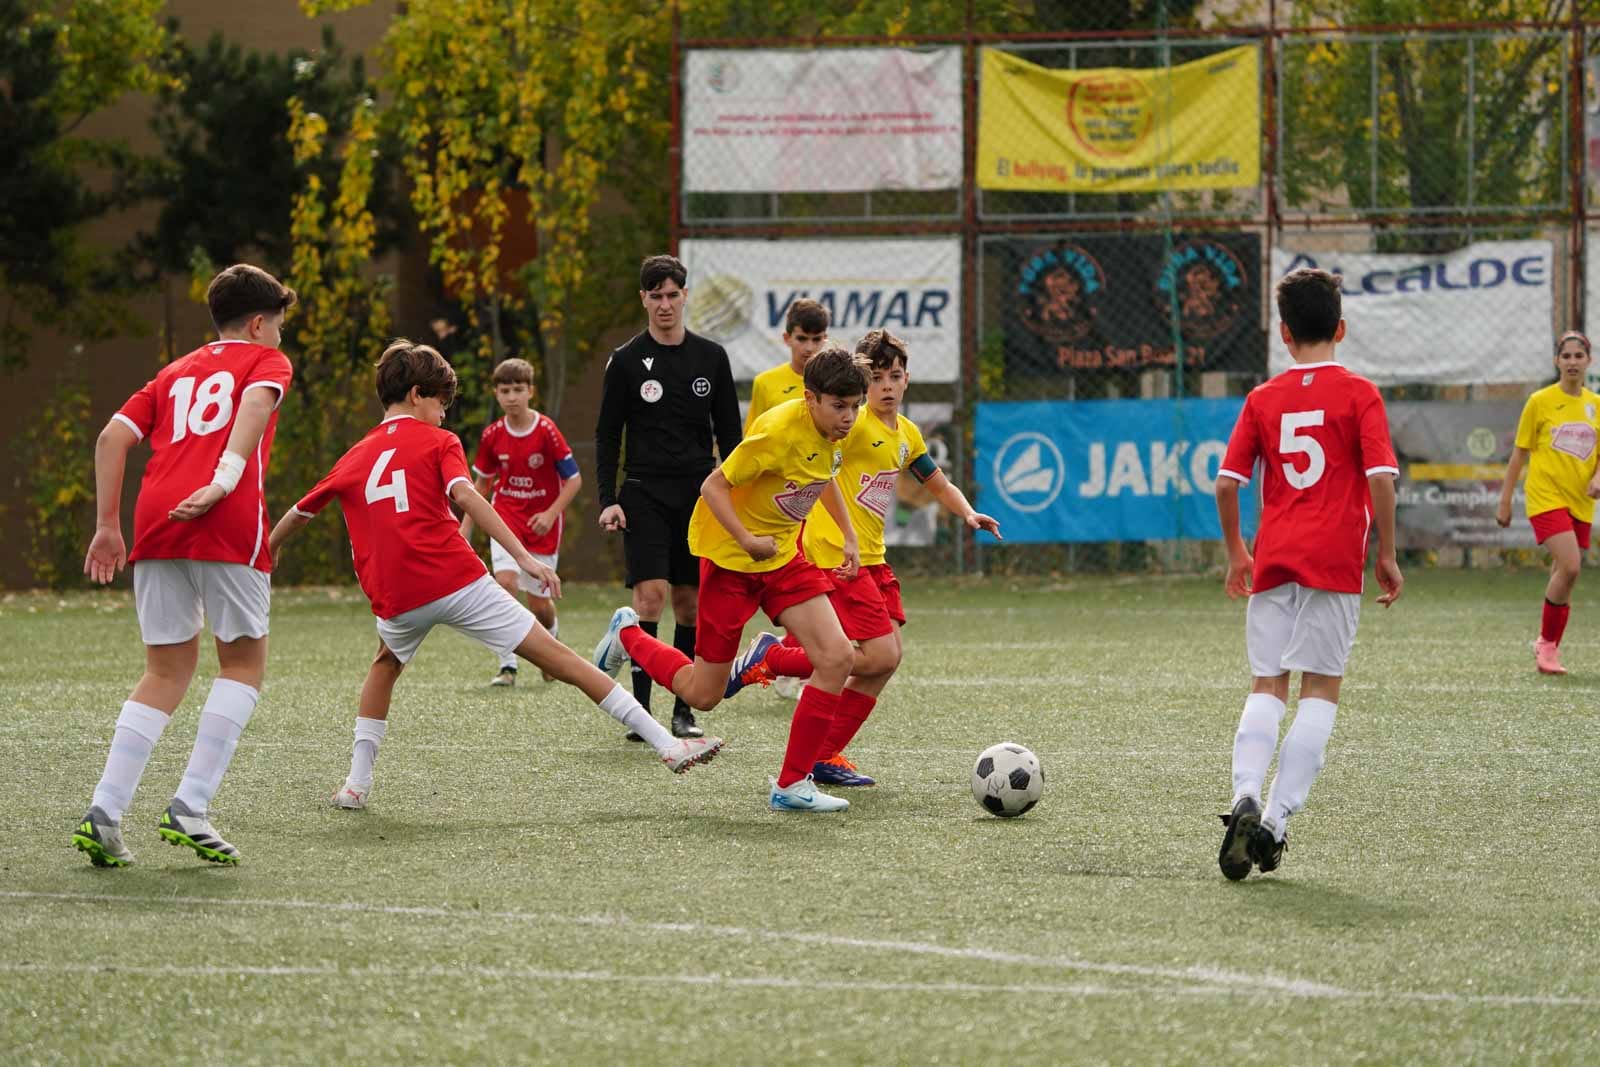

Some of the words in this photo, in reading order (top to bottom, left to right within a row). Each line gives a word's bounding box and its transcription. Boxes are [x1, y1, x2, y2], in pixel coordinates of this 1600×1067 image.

[765, 288, 950, 328] VAMAR
[168, 370, 236, 444] 18
[364, 447, 410, 513] 4
[1079, 439, 1230, 498] JAKO
[1279, 409, 1326, 490] 5
